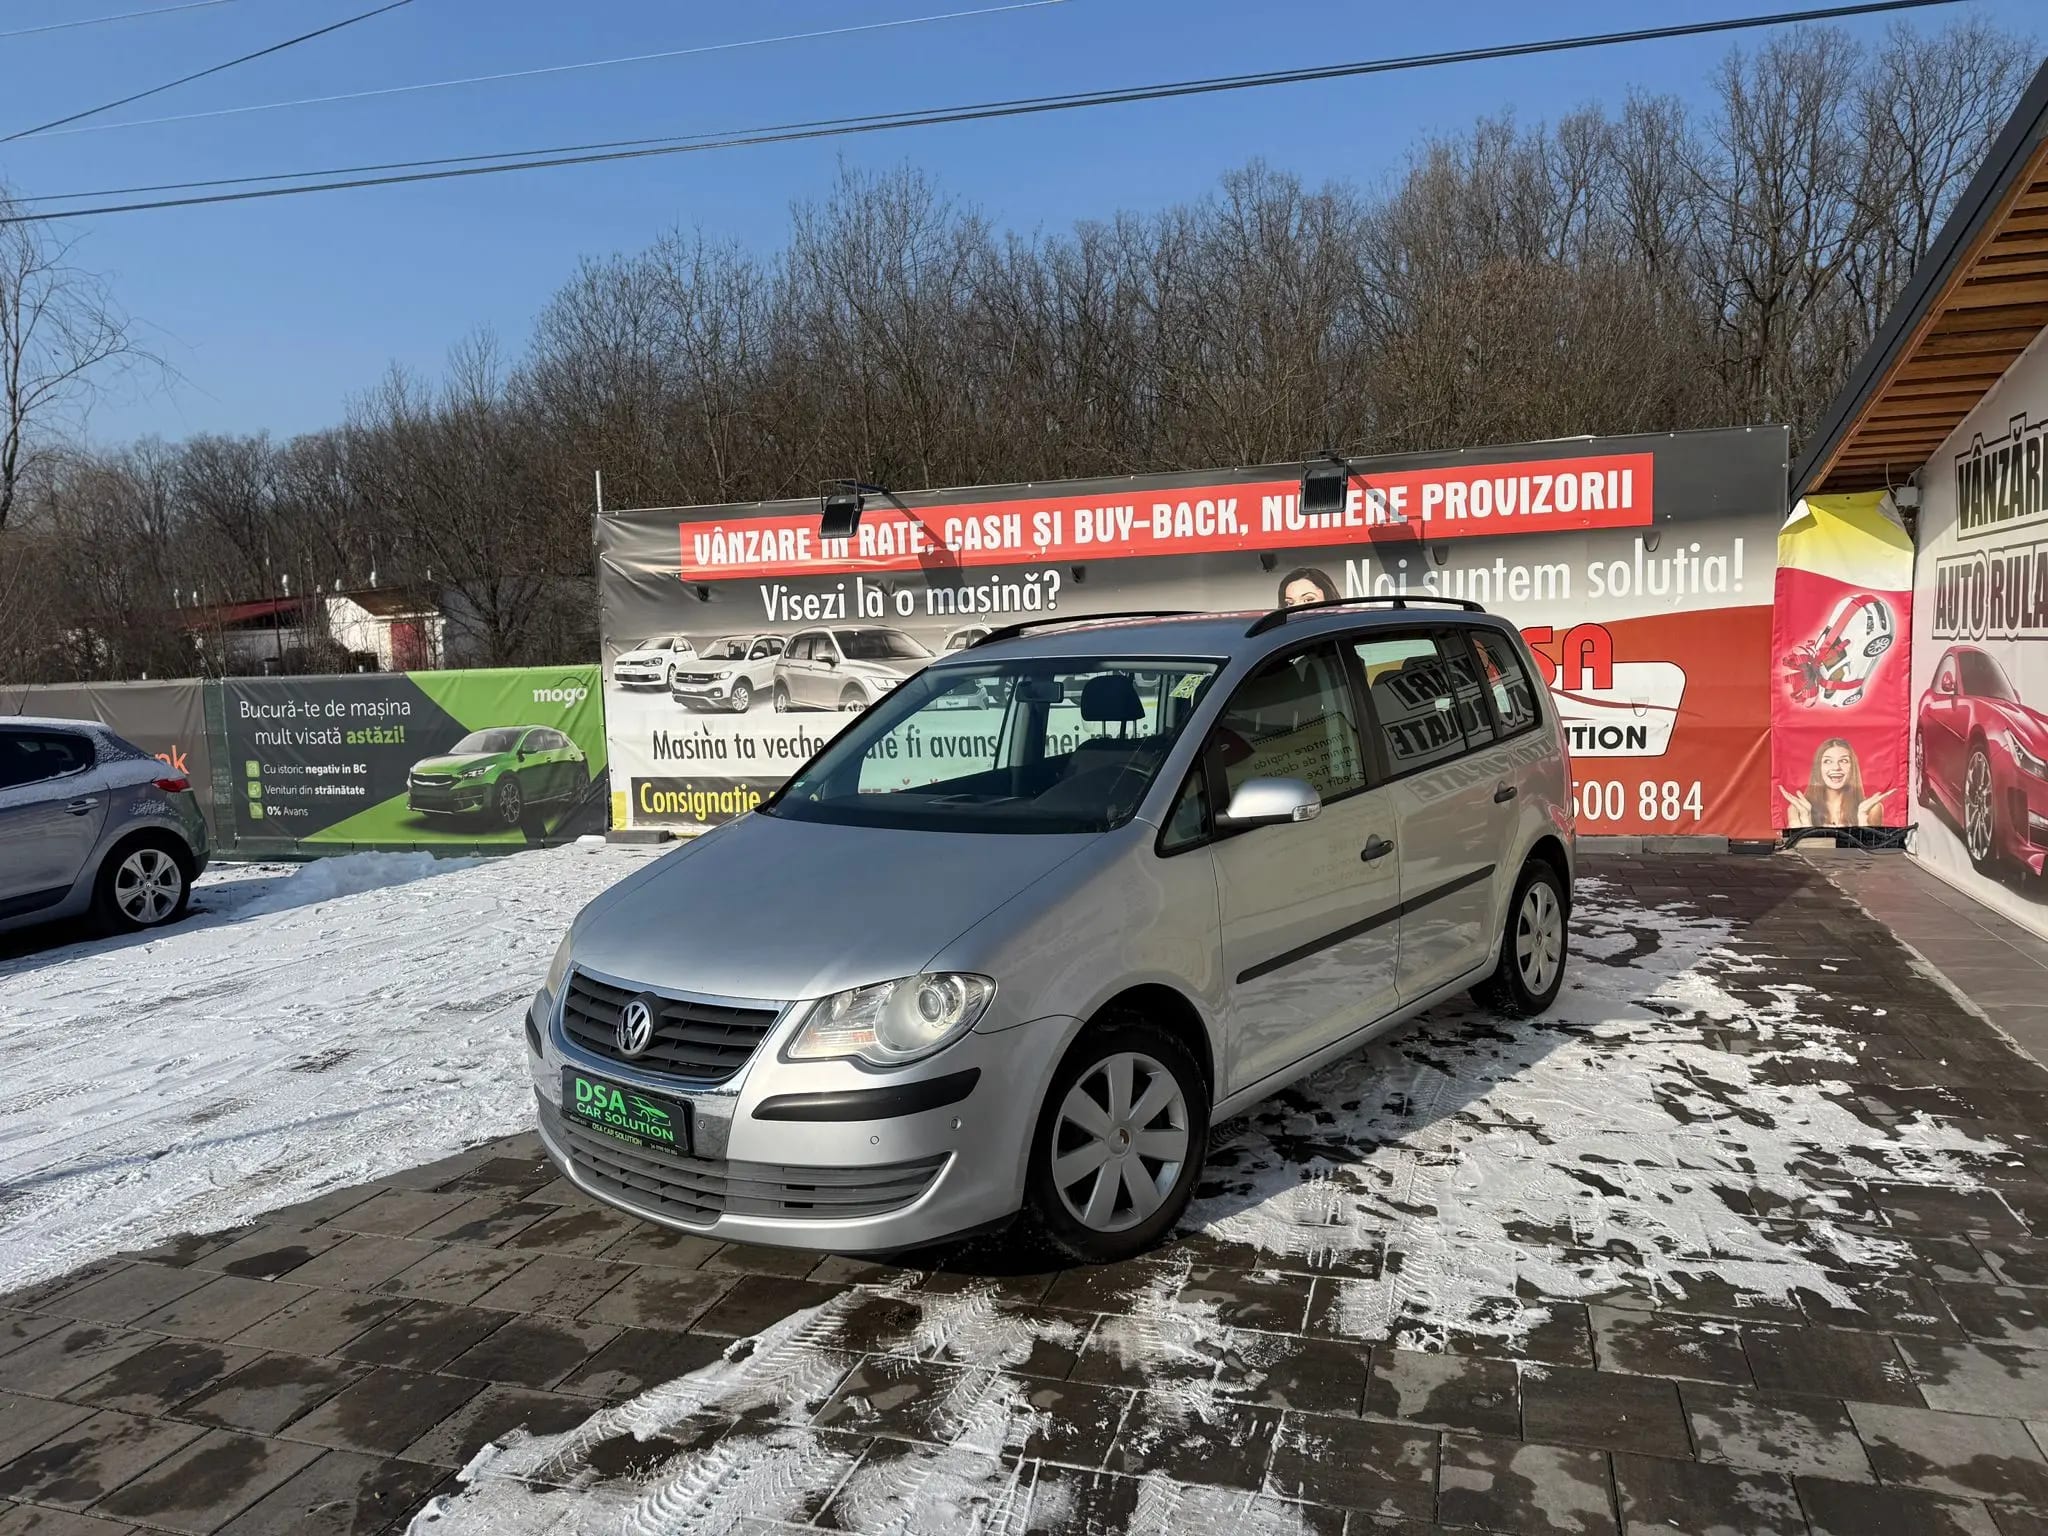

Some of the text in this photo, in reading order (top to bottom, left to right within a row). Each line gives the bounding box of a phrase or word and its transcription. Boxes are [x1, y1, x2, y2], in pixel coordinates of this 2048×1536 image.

[694, 526, 811, 566] VÂNZARE
[859, 520, 935, 556] RATE,
[944, 513, 1022, 552] CASH
[1032, 510, 1064, 554] ȘI
[1422, 469, 1633, 521] PROVIZORII
[1345, 537, 1744, 606] Noi suntem soluția!
[760, 569, 1061, 622] Visezi la o mașină?
[1935, 559, 1987, 630] AUTO
[240, 698, 411, 720] Bucură-te de mașina
[532, 687, 588, 709] mogo
[255, 725, 406, 745] mult visată astăzi!
[733, 733, 756, 759] ta
[762, 724, 825, 759] veche
[906, 724, 922, 758] fi
[263, 763, 276, 775] Cu
[278, 764, 304, 775] istoric
[305, 763, 341, 777] negativ
[353, 763, 367, 774] BC
[264, 784, 366, 795] Venituri din străinătate
[1638, 780, 1704, 821] 884
[266, 806, 309, 817] 0% Avans
[575, 1077, 628, 1116] DSA
[576, 1102, 602, 1120] CAR
[604, 1111, 674, 1142] SOLUTION
[614, 1130, 643, 1148] SOLUTION
